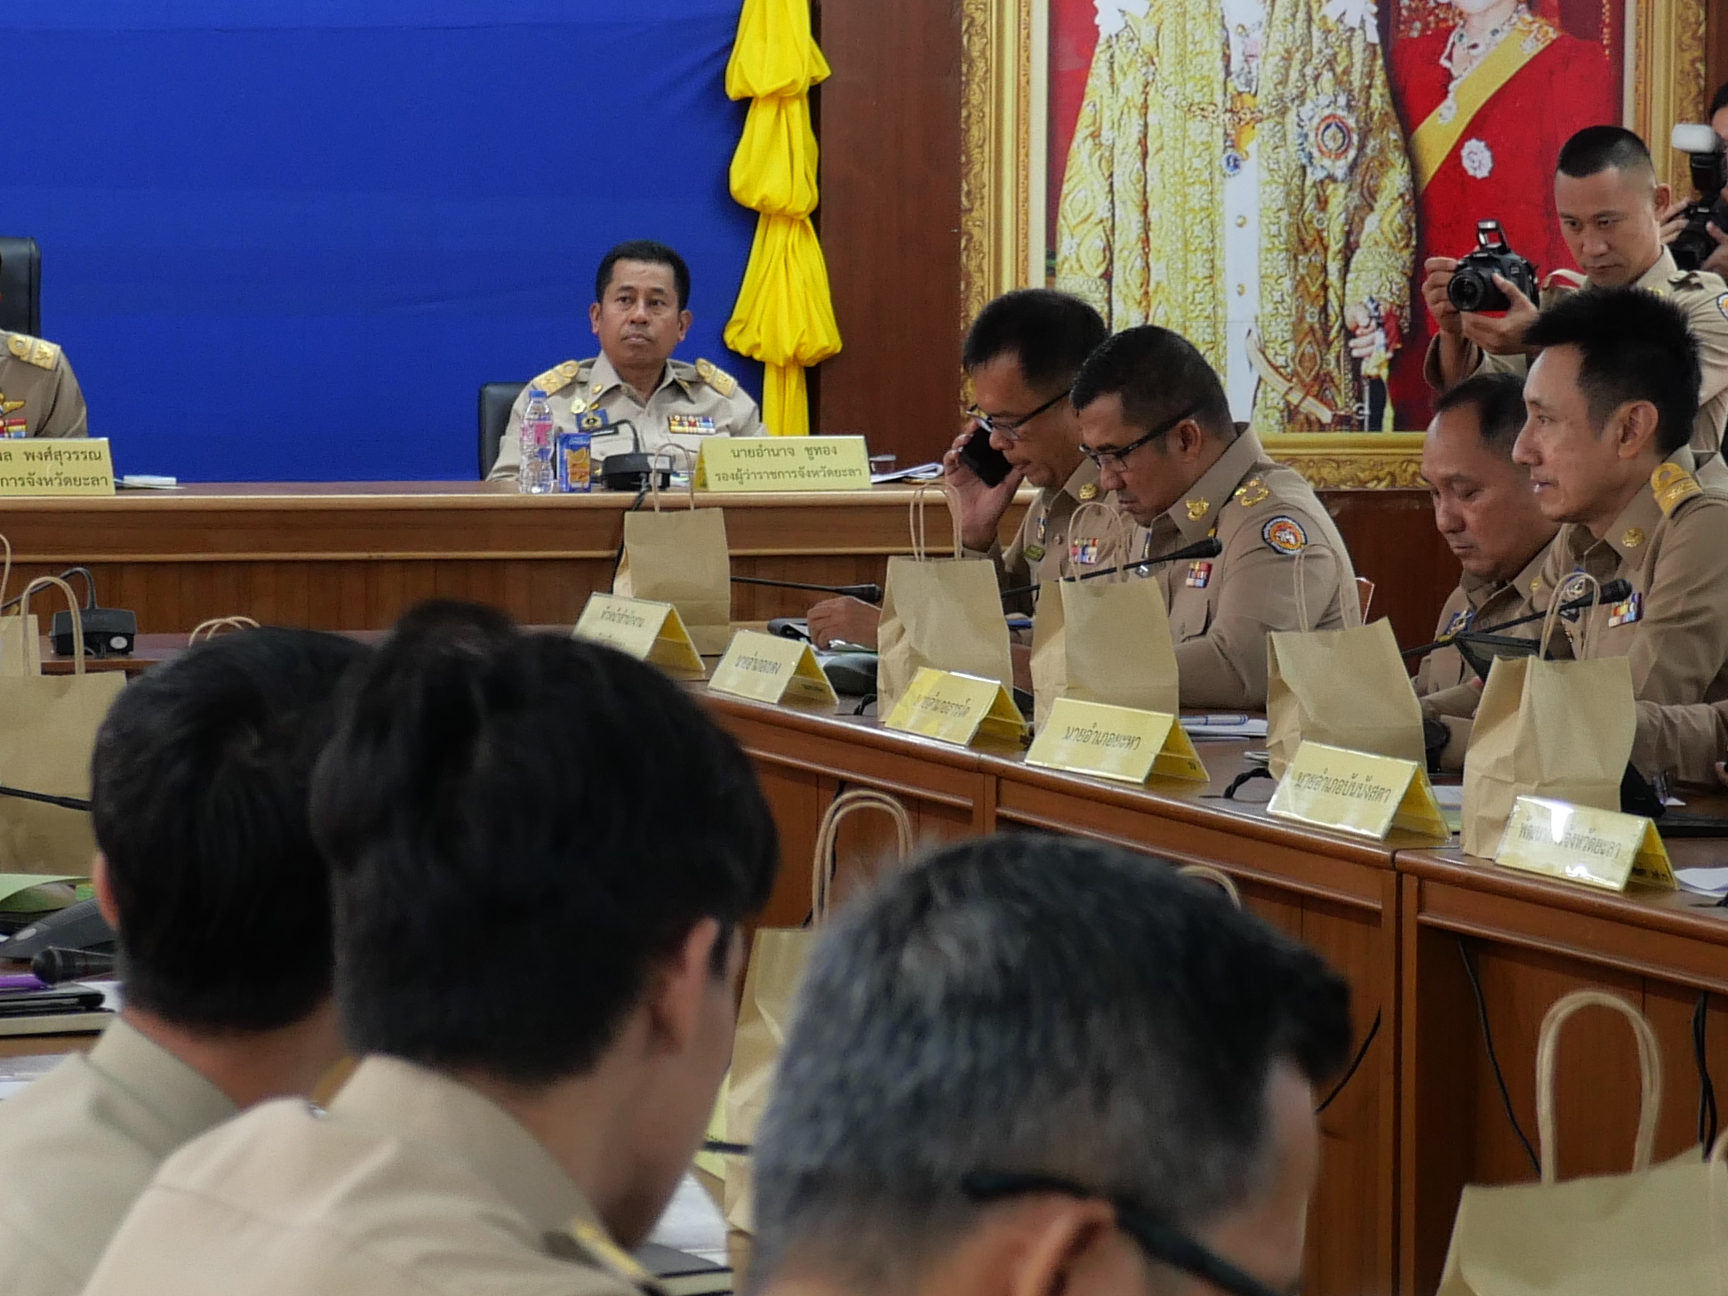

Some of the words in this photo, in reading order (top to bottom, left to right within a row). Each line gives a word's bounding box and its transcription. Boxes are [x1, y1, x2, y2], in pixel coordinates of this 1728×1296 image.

[731, 444, 795, 459] นายอำนาจ
[804, 444, 838, 461] ชูทอง
[715, 466, 862, 485] รองผู้ว่าราชการจังหวัดยะลา
